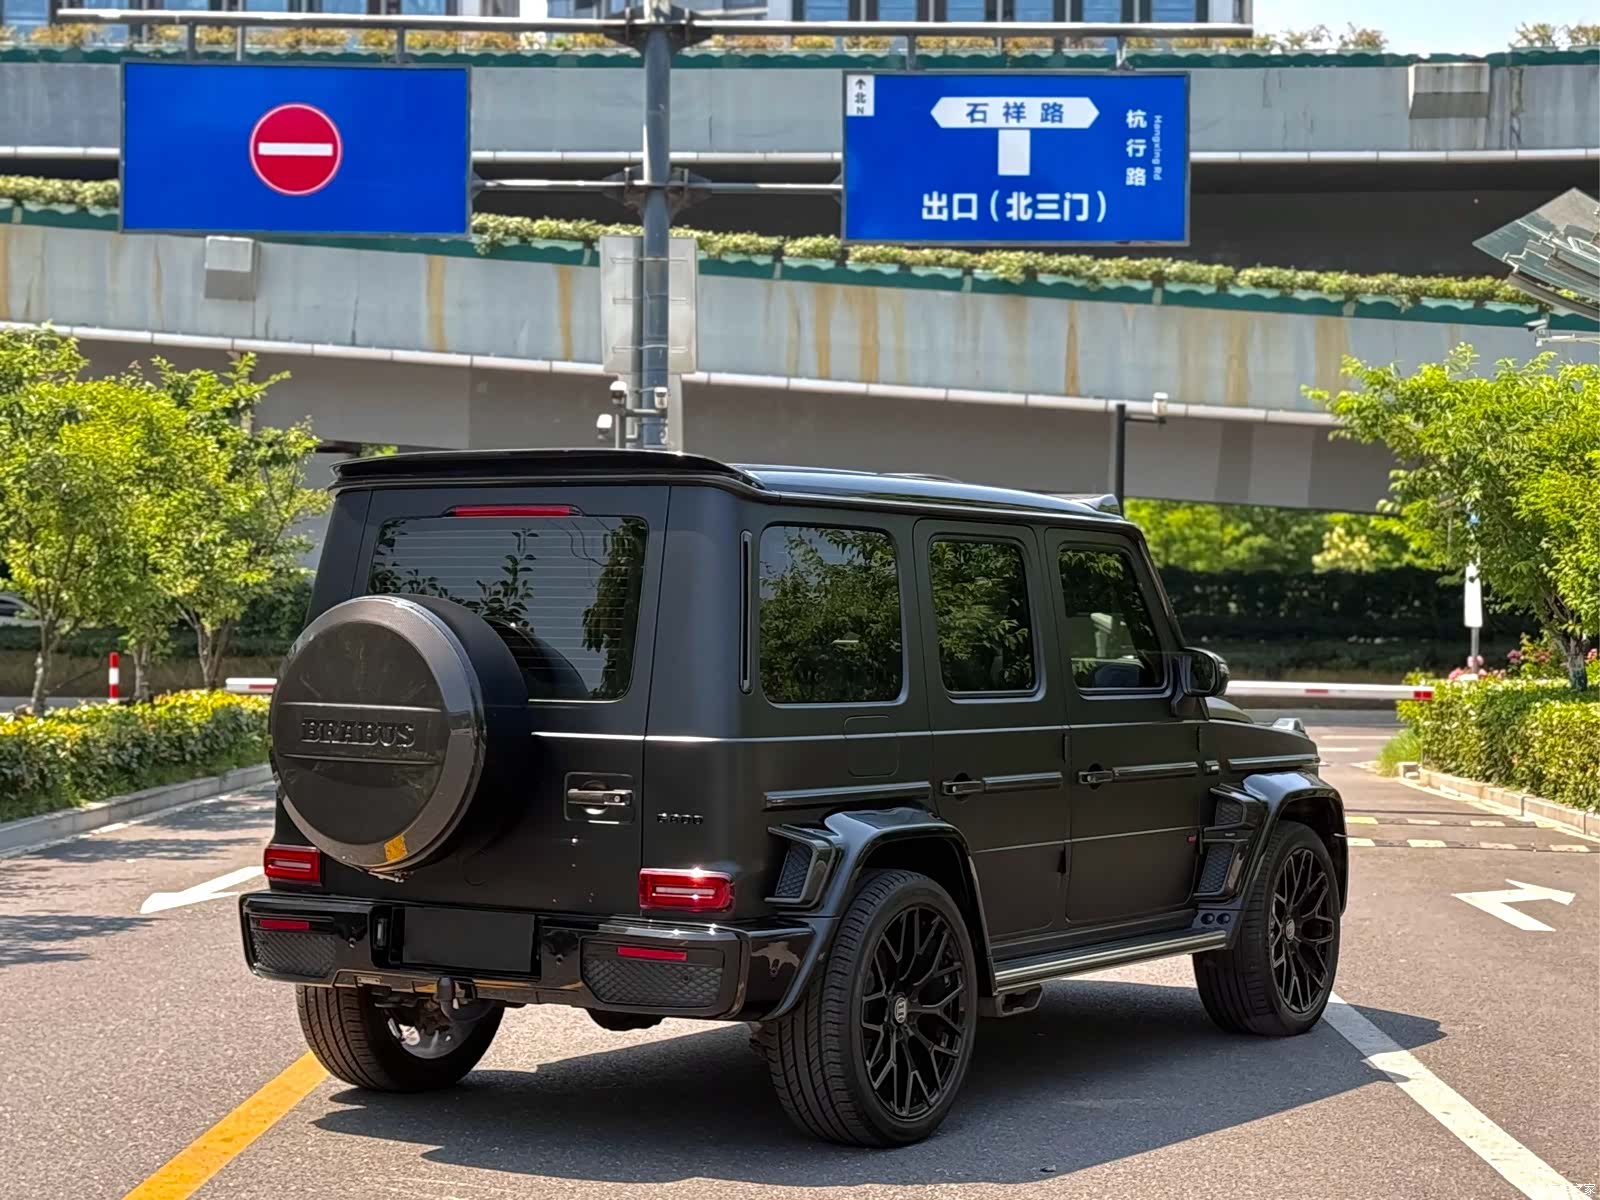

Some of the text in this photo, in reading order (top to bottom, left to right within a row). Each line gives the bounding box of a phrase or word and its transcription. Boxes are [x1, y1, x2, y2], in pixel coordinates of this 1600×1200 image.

[854, 91, 867, 104] 北
[856, 106, 864, 115] N
[966, 102, 1064, 124] 石祥路
[1125, 108, 1147, 187] 杭行路
[301, 719, 416, 748] BRABUS
